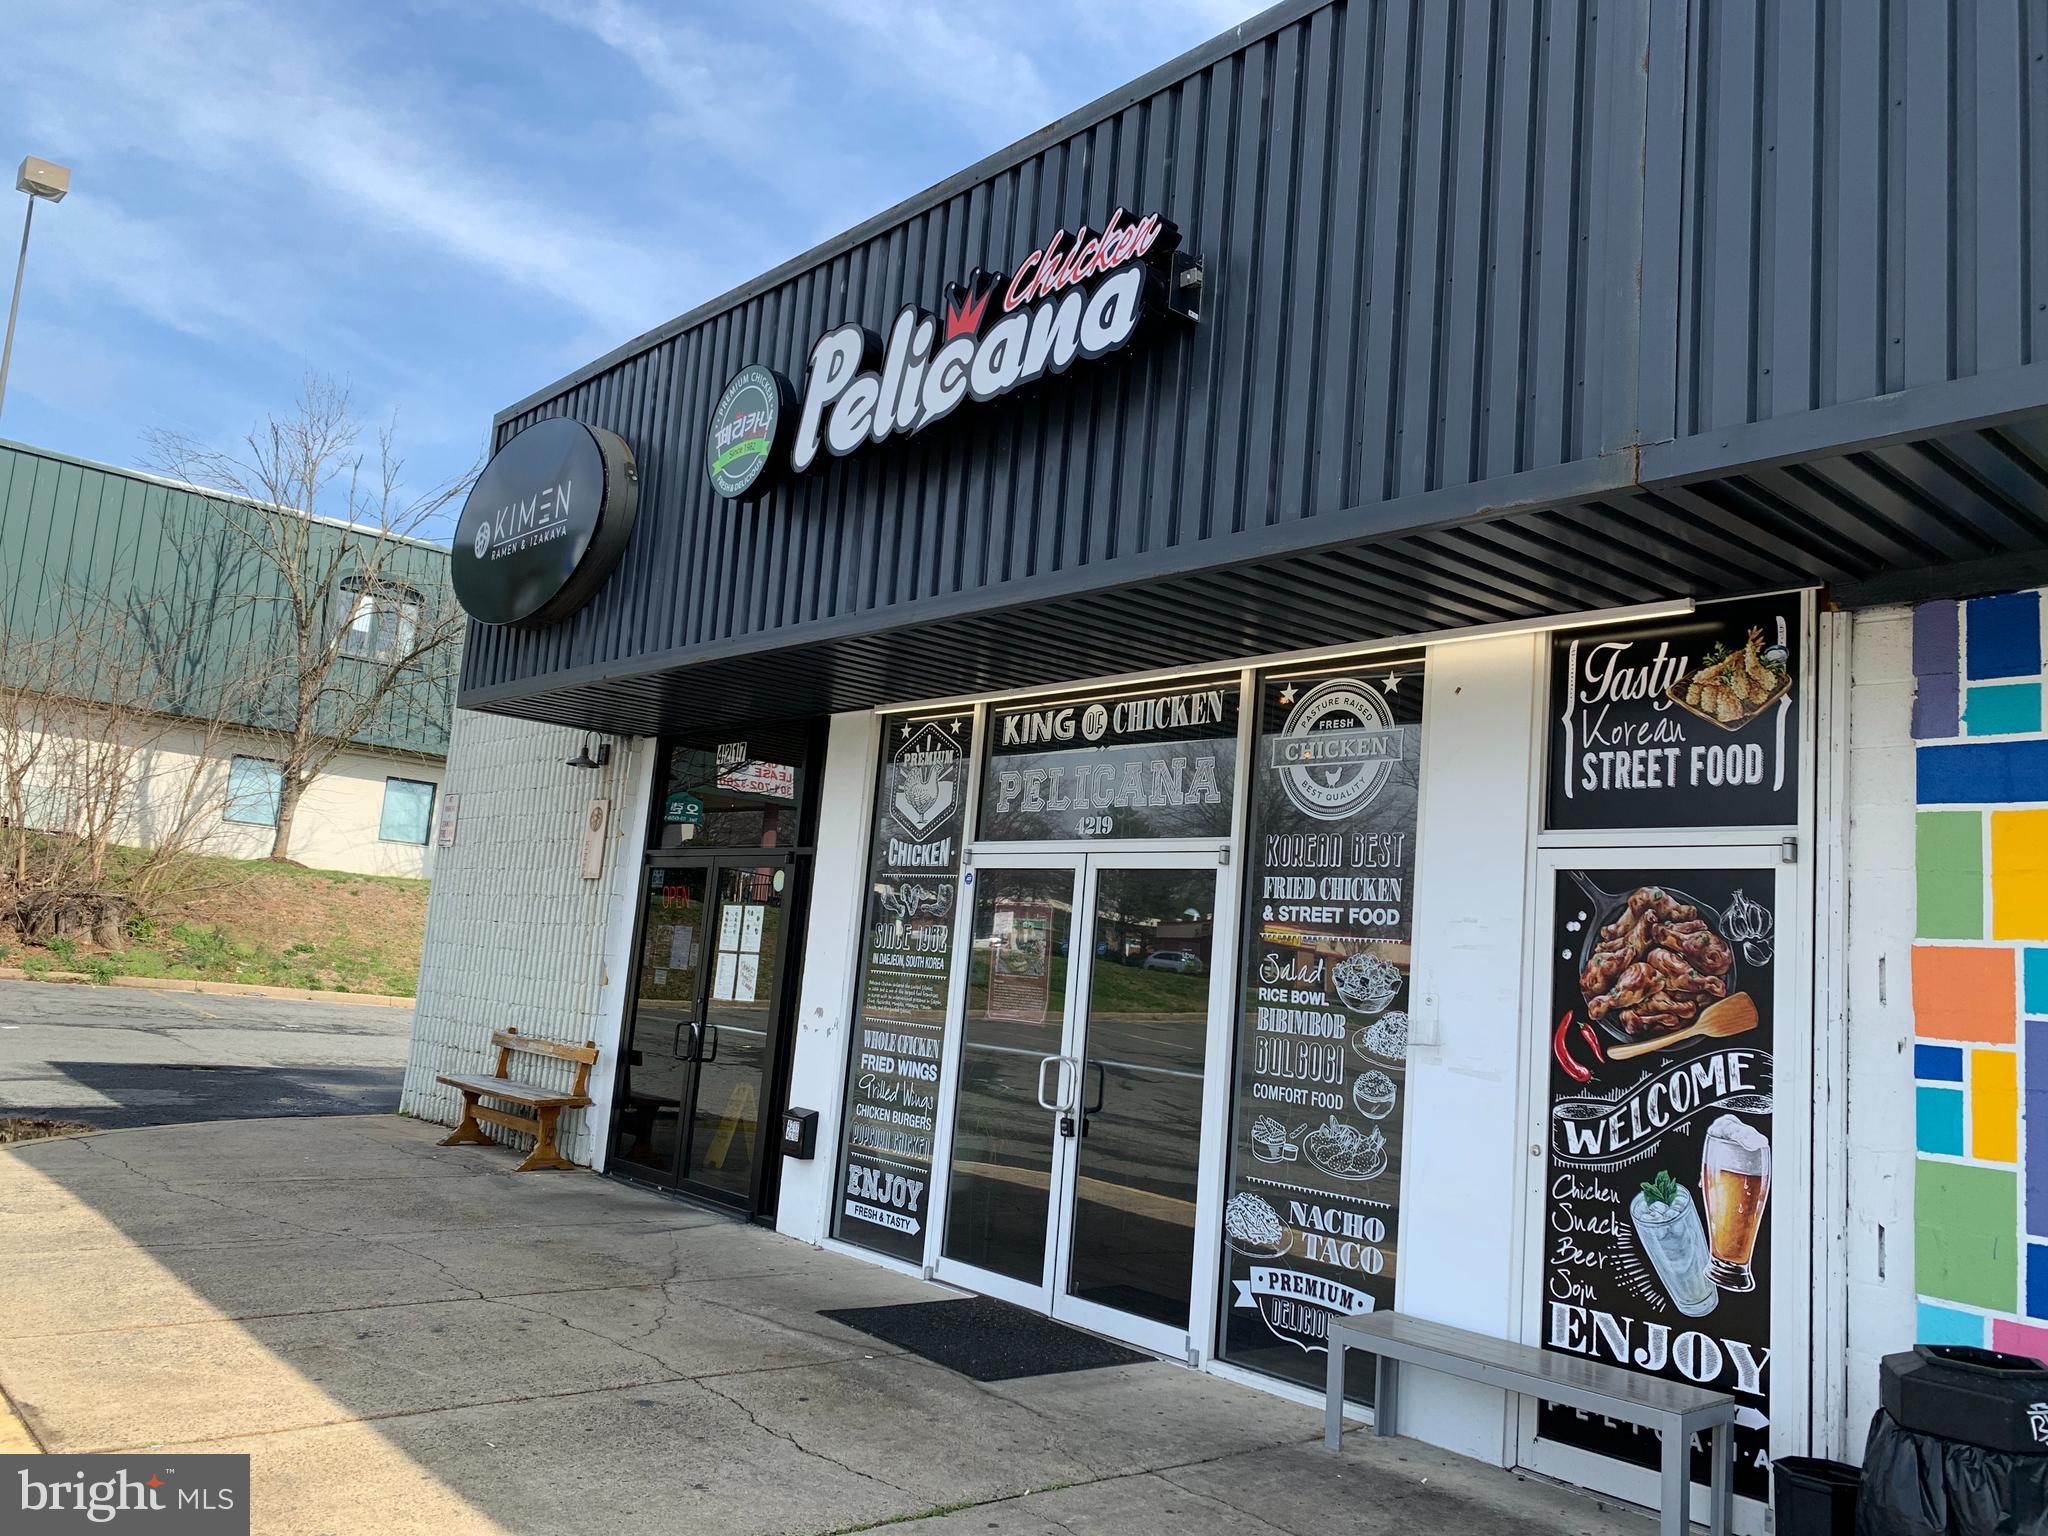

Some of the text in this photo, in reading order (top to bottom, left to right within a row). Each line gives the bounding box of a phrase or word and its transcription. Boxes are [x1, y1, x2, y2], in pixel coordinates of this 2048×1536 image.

[1003, 207, 1163, 312] Chicken
[793, 267, 1142, 468] Pelicana
[719, 372, 774, 416] PREMIUM CHICKEN
[729, 446, 743, 459] Since
[734, 460, 763, 491] DELICIOUS
[494, 480, 571, 543] KIMEN
[491, 525, 567, 561] RAMEN & IZAKAYA
[1580, 641, 1688, 711] Tasty
[1002, 690, 1225, 746] KING OF CHICKEN
[1301, 697, 1373, 728] PASTURE RAISED
[1319, 718, 1354, 729] FRESH
[1582, 704, 1686, 748] Korean
[717, 742, 747, 764] 4217
[904, 750, 954, 767] PREMIUM
[1285, 736, 1390, 761] CHICKEN
[1581, 743, 1764, 791] STREET FOOD
[997, 756, 1221, 812] PELICANA
[1301, 776, 1366, 801] BEST QUALITY
[1075, 816, 1113, 835] 4219
[888, 836, 951, 867] CHICKEN
[1264, 832, 1405, 868] KOREAN BEST
[662, 886, 691, 909] OPEN
[1263, 876, 1402, 902] FRIED CHICKEN
[1262, 905, 1400, 926] & STREET FOOD
[873, 922, 949, 953] SINCE 1982
[872, 952, 879, 964] IN
[906, 955, 925, 968] SOUTH
[925, 957, 944, 970] KOREA
[1259, 953, 1324, 984] Salad
[1258, 988, 1329, 1006] RICE BOWL
[1257, 1006, 1346, 1039] BIBIMBOB
[864, 1029, 940, 1059] WHOLE CHICKEN
[1255, 1036, 1344, 1085] BULGOGI
[861, 1053, 938, 1082] FRIED WINGS
[858, 1073, 934, 1118] Grilled Wings
[1253, 1082, 1344, 1110] COMFORT FOOD
[1563, 1052, 1756, 1155] WELCOME
[856, 1103, 932, 1131] CHICKEN BURGERS
[847, 1163, 924, 1212] ENJOY
[1552, 1174, 1621, 1204] Chicken
[854, 1204, 910, 1230] FRESH & TASTY
[1288, 1200, 1385, 1243] NACHO
[1552, 1203, 1623, 1237] Snack
[1301, 1232, 1384, 1275] TACO
[1550, 1236, 1609, 1270] Beer
[1268, 1271, 1354, 1310] PREMIUM
[1550, 1269, 1597, 1304] Soju
[1272, 1297, 1341, 1340] DELICIOU
[1548, 1301, 1771, 1397] ENJOY
